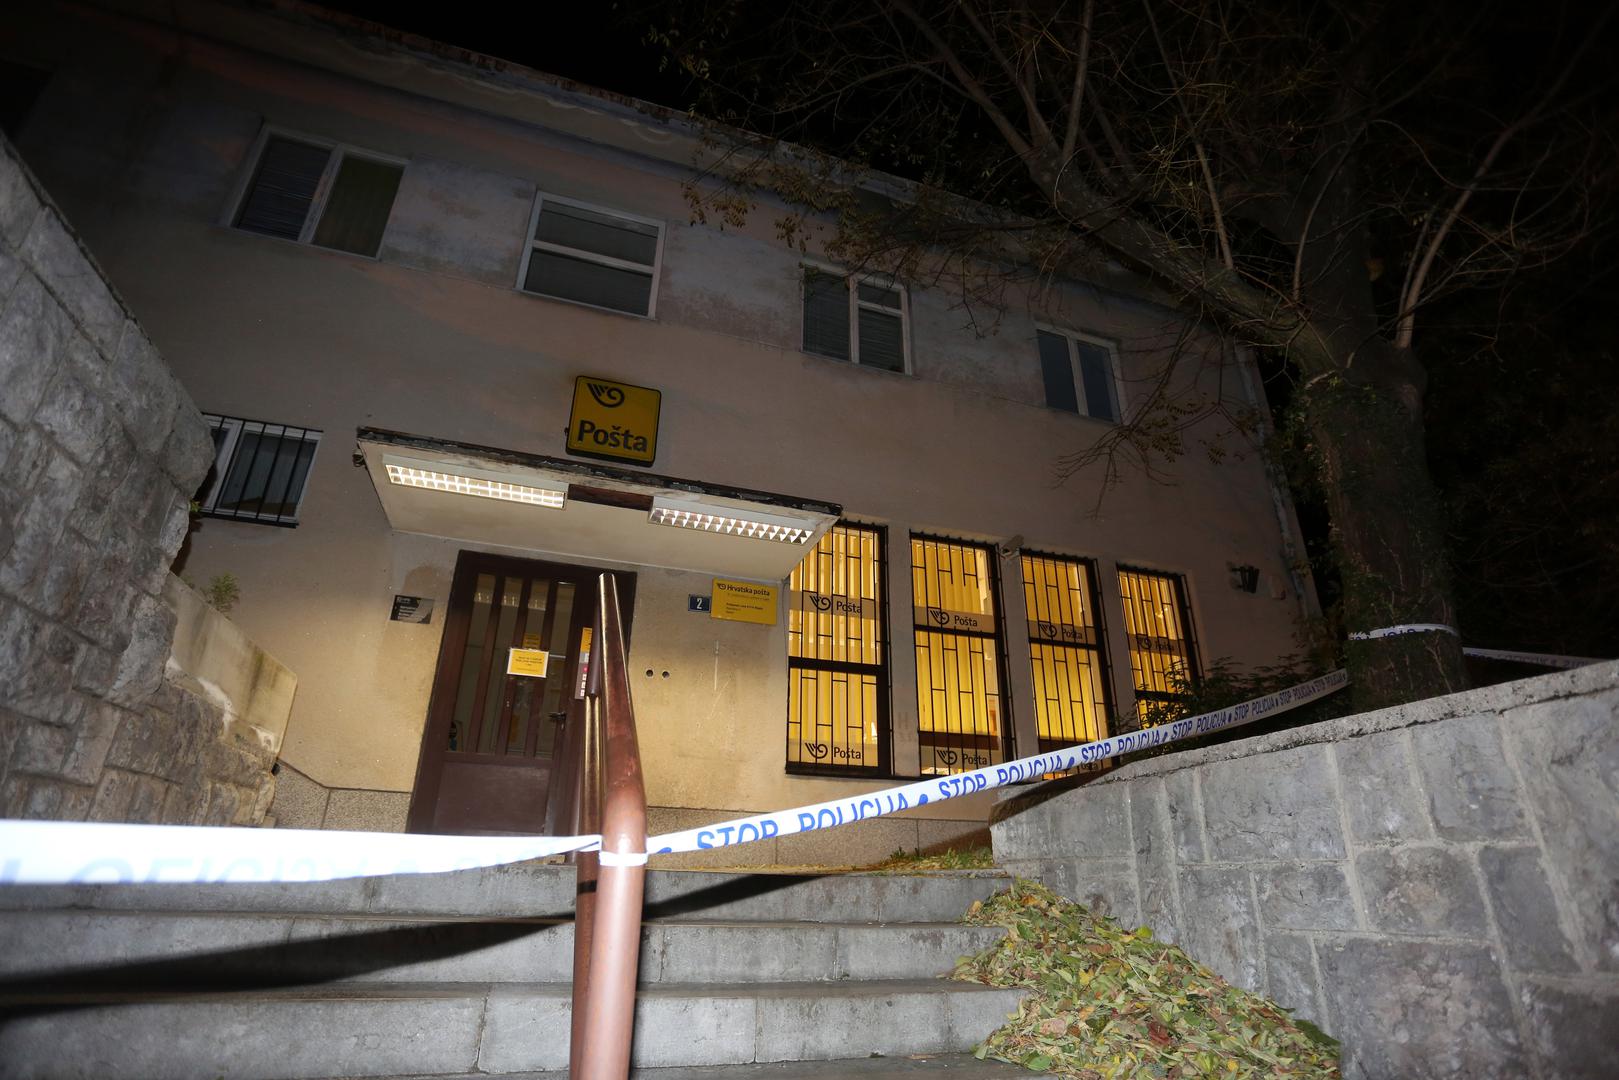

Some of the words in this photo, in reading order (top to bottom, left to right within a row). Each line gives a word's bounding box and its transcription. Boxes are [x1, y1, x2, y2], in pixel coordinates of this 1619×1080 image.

[577, 420, 647, 453] Pošta
[727, 584, 753, 594] Hrvatska
[753, 588, 770, 596] pošta
[696, 597, 703, 610] 2
[836, 601, 861, 613] Pošta
[954, 615, 978, 627] Pošta
[833, 747, 861, 759] Pošta
[962, 753, 988, 766] Pošta
[697, 819, 779, 850] STOP
[798, 792, 909, 833] POLICIJA
[938, 773, 987, 800] STOP
[997, 756, 1062, 785] POLICIJA
[1081, 740, 1112, 763] STOP
[1118, 730, 1160, 753] POLICIJA
[1172, 723, 1193, 740] STOP
[1197, 711, 1226, 734] POLICIJA
[1234, 707, 1250, 721] STOP
[1252, 698, 1275, 717] POLICIJA
[1279, 691, 1292, 706] STOP
